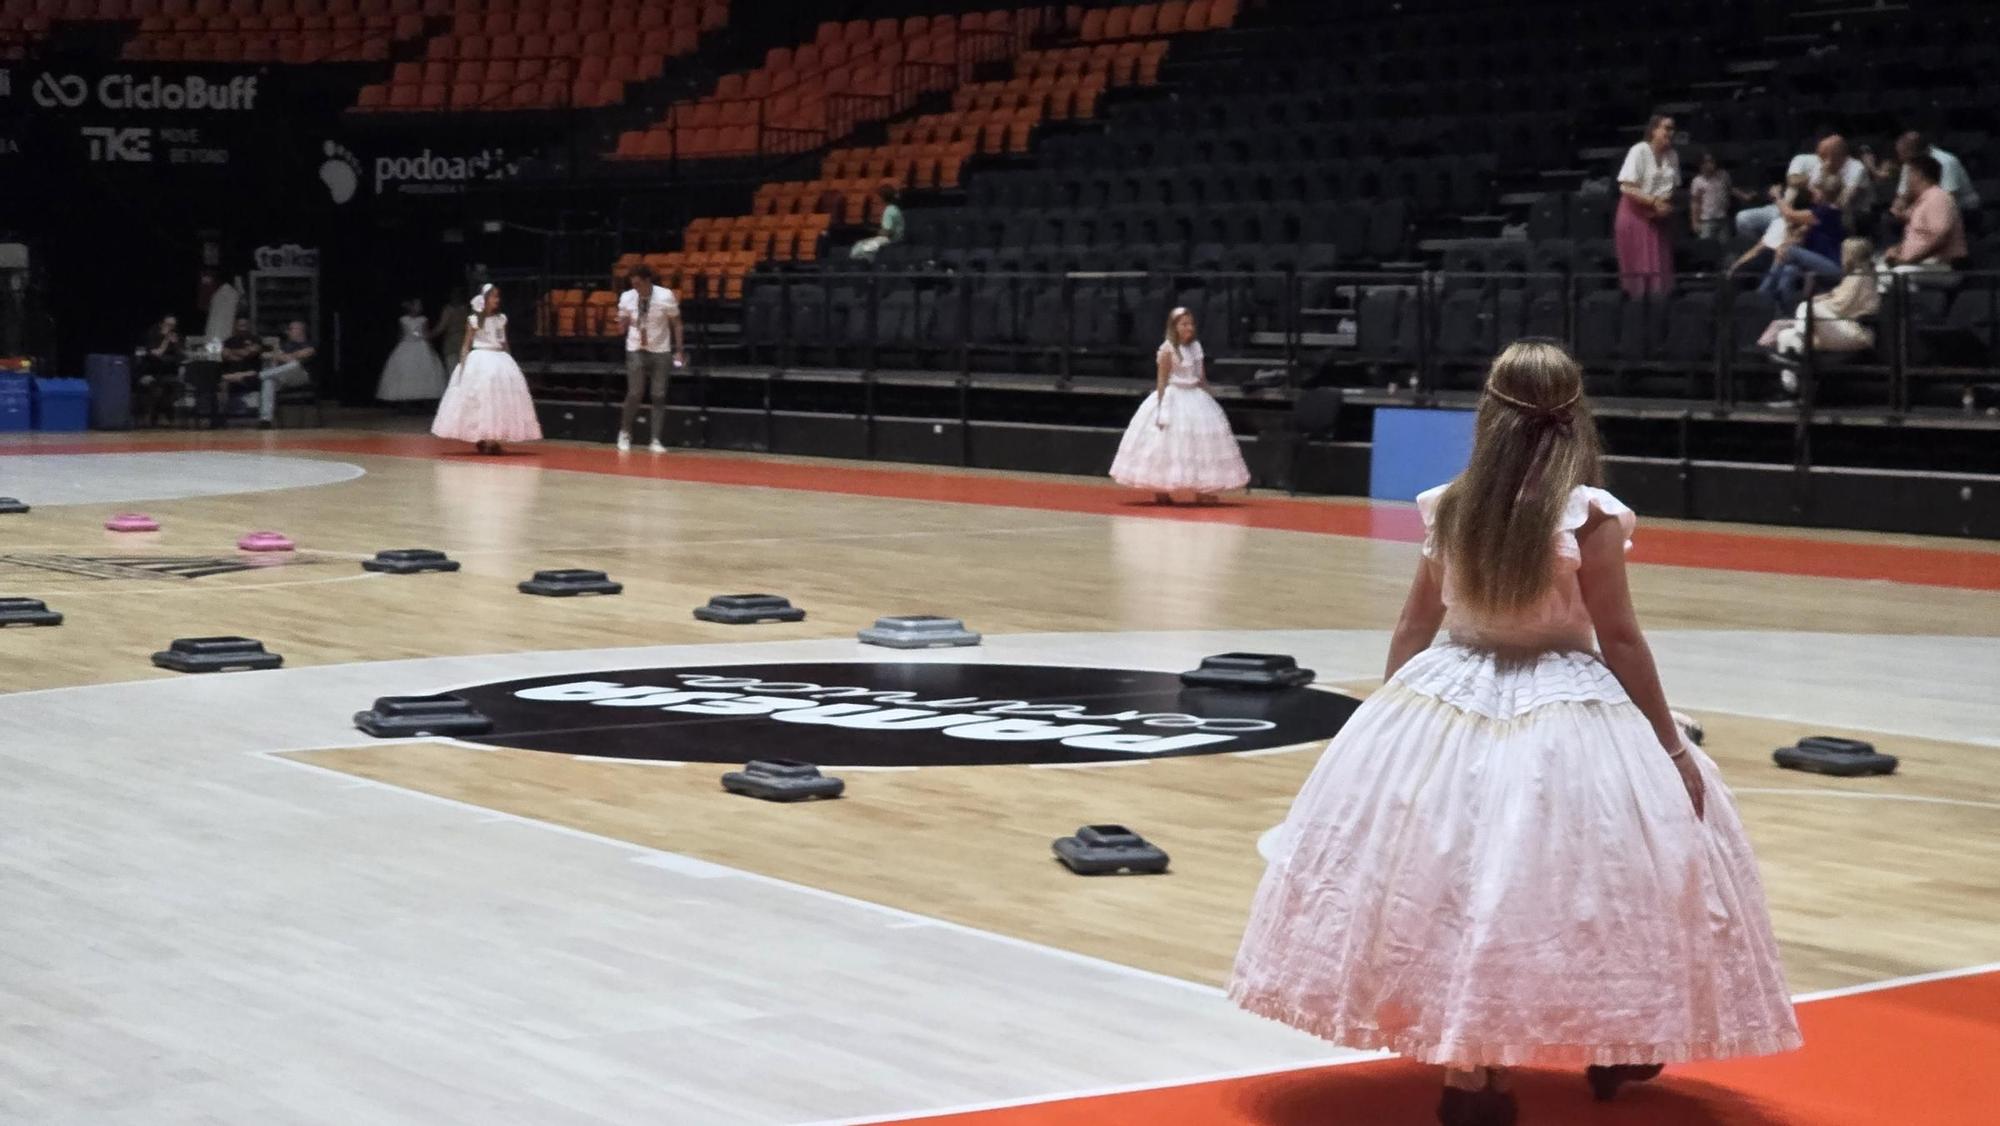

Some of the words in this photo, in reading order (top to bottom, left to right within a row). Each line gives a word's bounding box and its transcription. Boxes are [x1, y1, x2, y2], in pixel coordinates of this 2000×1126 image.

[98, 74, 258, 110] CicloBuff
[81, 127, 151, 161] TKE
[514, 681, 1238, 753] PAMESA
